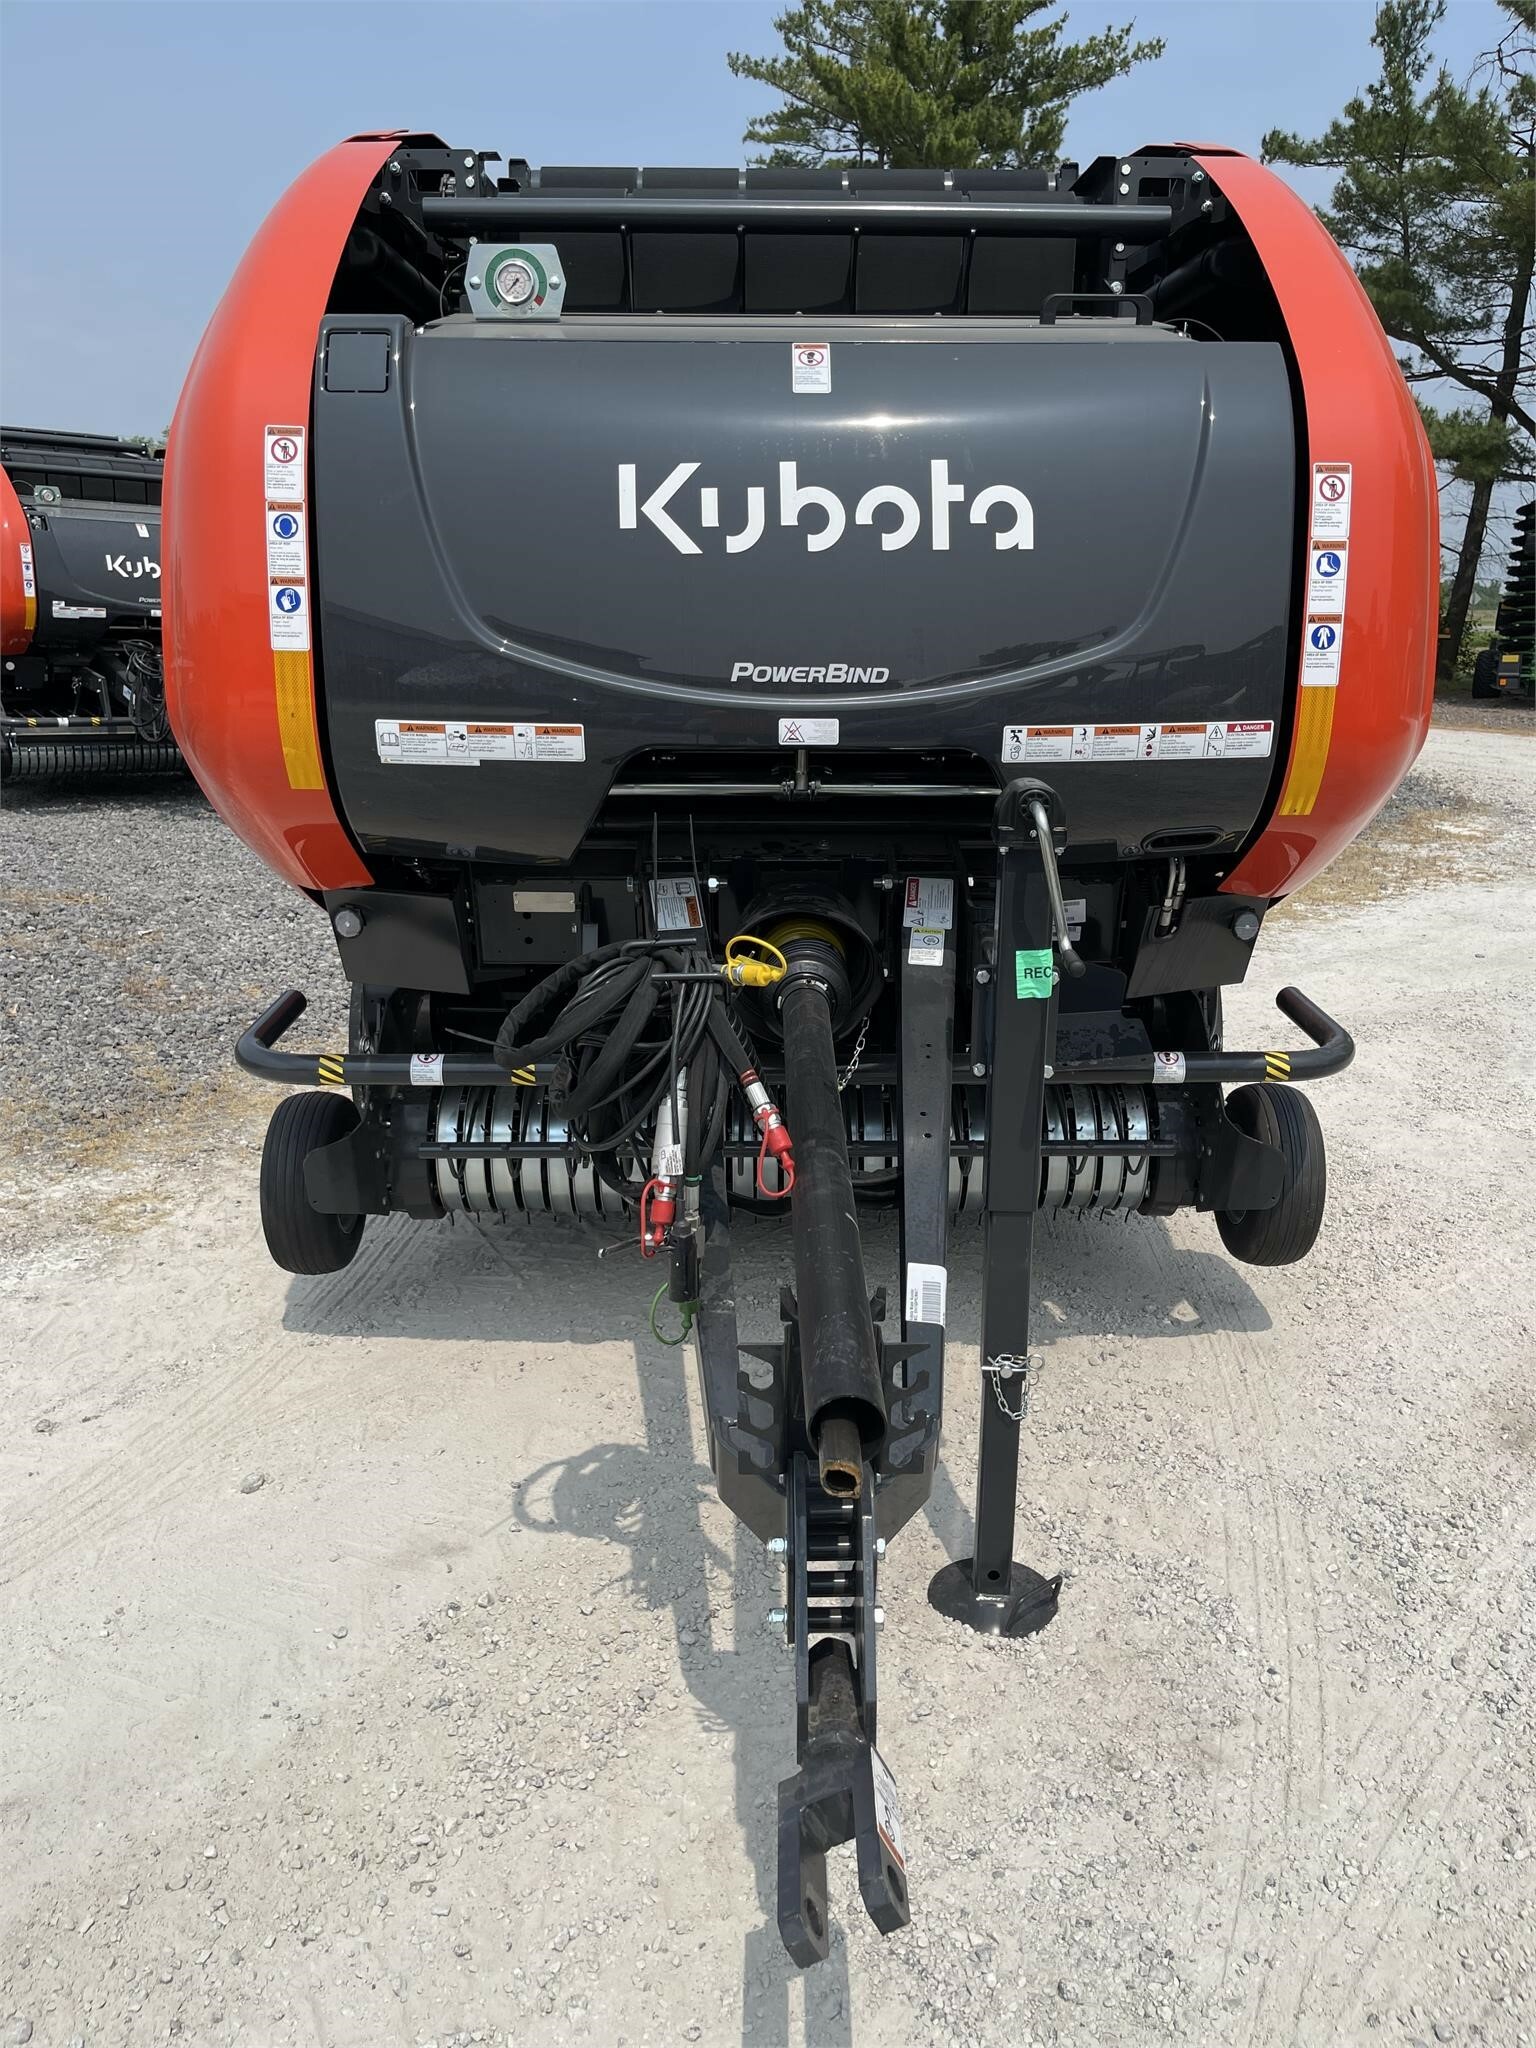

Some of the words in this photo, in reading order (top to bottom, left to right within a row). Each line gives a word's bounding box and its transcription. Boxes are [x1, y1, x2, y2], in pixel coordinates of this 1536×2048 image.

[618, 459, 1034, 555] Kubota
[105, 554, 161, 579] Kub
[1023, 967, 1052, 979] REC
